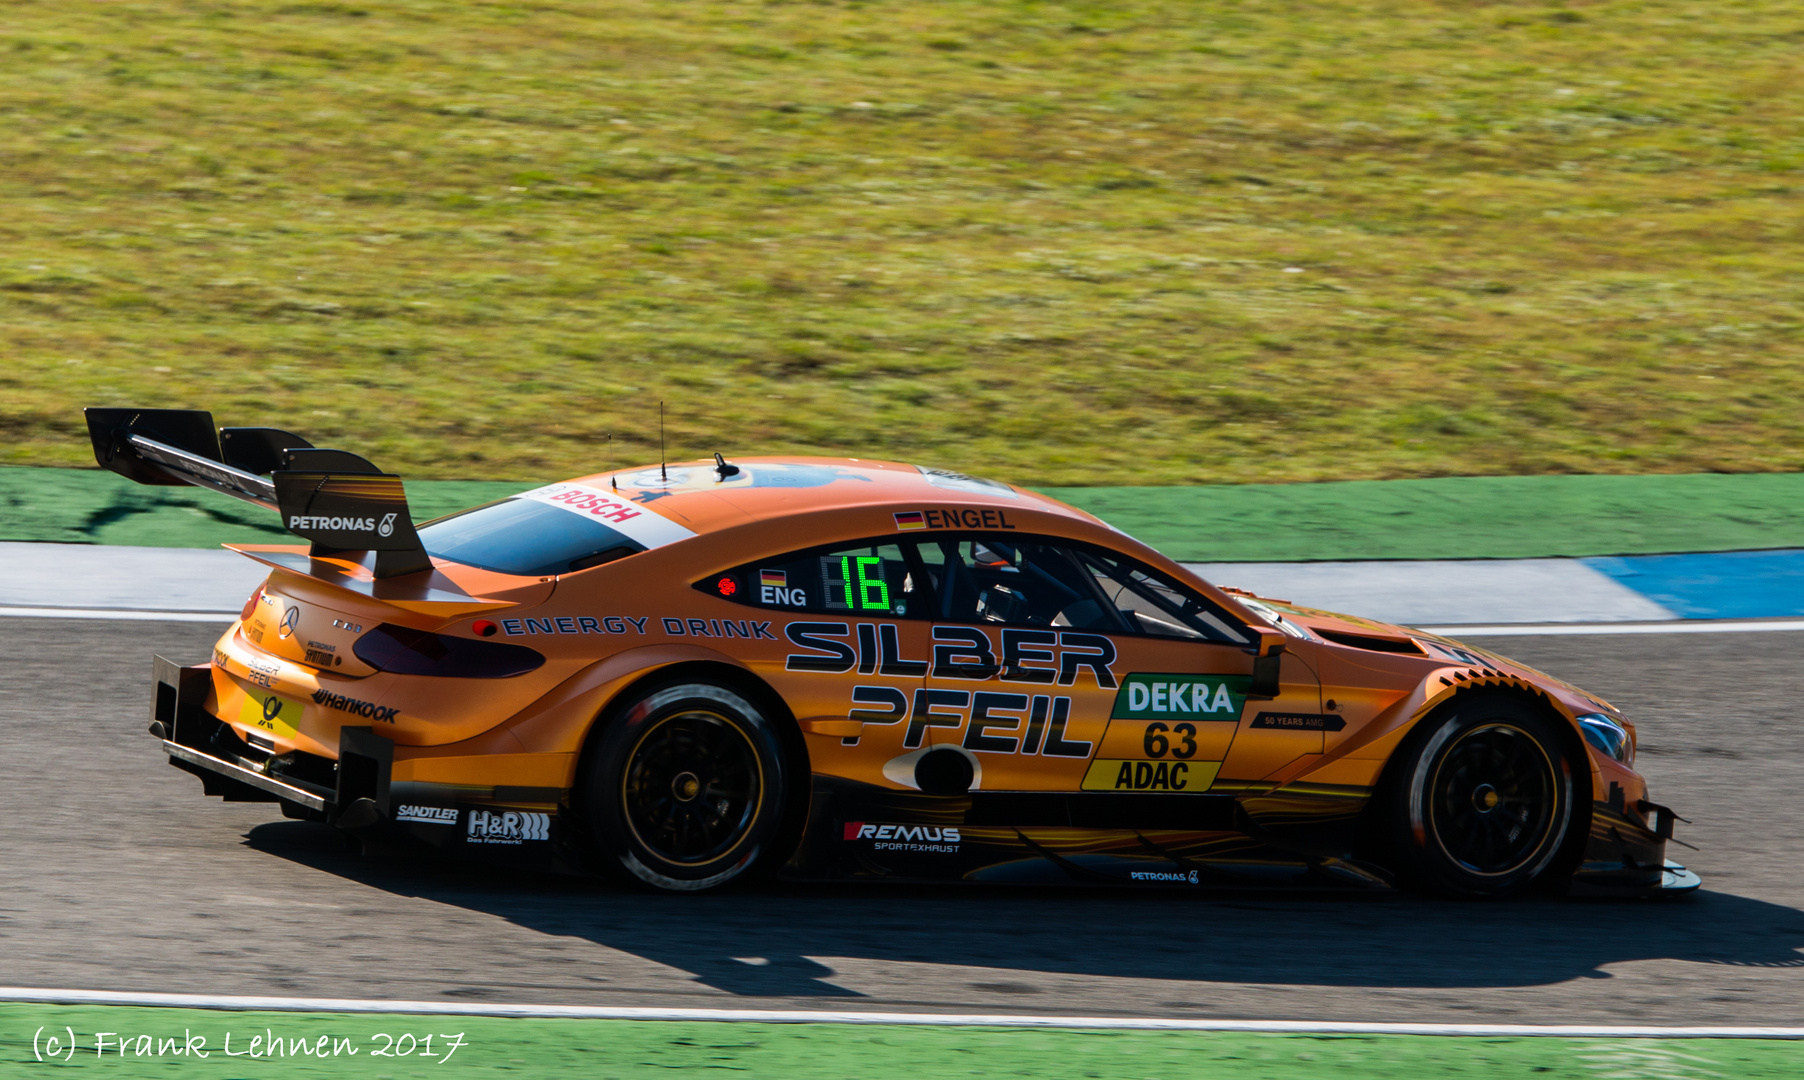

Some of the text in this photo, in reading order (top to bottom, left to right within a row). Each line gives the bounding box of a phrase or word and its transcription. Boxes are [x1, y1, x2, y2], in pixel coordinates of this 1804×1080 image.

[550, 490, 643, 524] BOSCH
[289, 515, 375, 532] PETRONAS
[924, 509, 1016, 530] ENGEL
[841, 556, 890, 609] 16
[761, 586, 807, 607] ENG
[502, 616, 779, 641] ENERGY DRINK
[307, 640, 337, 653] PETRONAS
[784, 621, 1120, 690] SILBER
[1128, 681, 1235, 714] DEKRA
[841, 685, 1094, 759] PFEIL
[1264, 716, 1325, 727] 50 YEARS AMG
[1143, 721, 1198, 759] 63
[1114, 761, 1189, 791] ADAC
[397, 804, 459, 820] SANDTLER
[467, 810, 524, 839] H&R
[856, 824, 962, 843] REMUS
[874, 842, 961, 853] SPORTEXHAUST
[1131, 871, 1187, 882] PETRONAS
